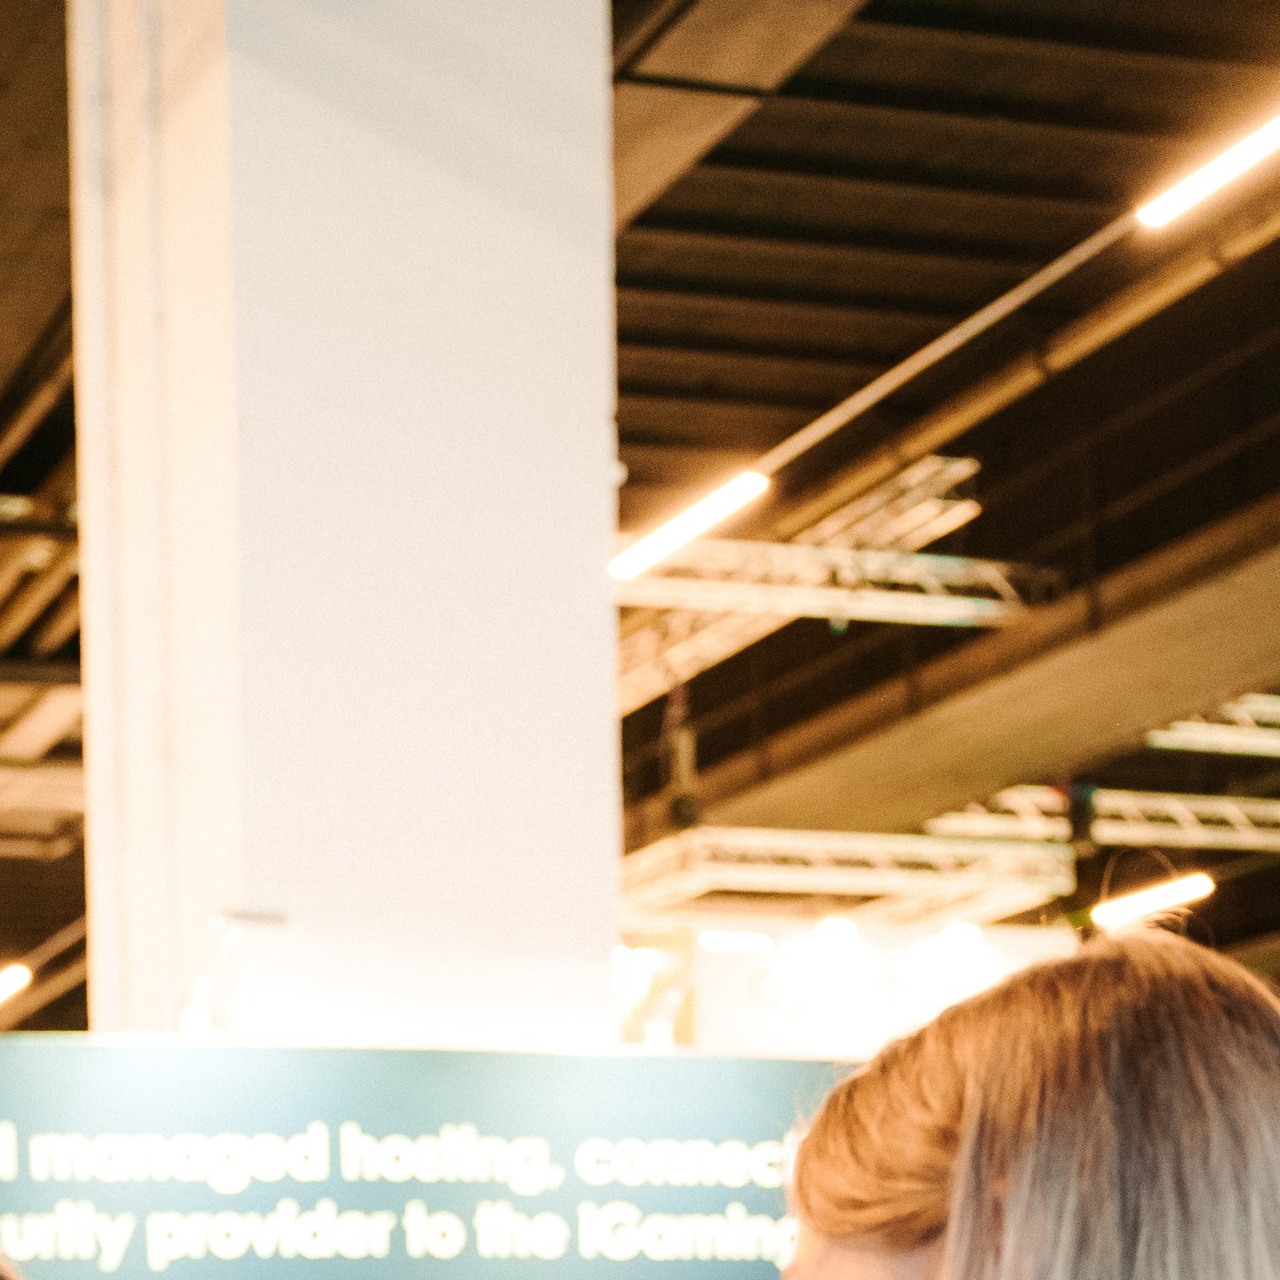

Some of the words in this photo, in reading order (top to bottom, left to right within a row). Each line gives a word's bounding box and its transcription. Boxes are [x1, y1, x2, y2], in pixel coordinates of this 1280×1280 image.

[27, 1119, 330, 1195] managed
[145, 1197, 397, 1272] provider
[402, 1198, 467, 1260] to
[472, 1199, 570, 1260] the
